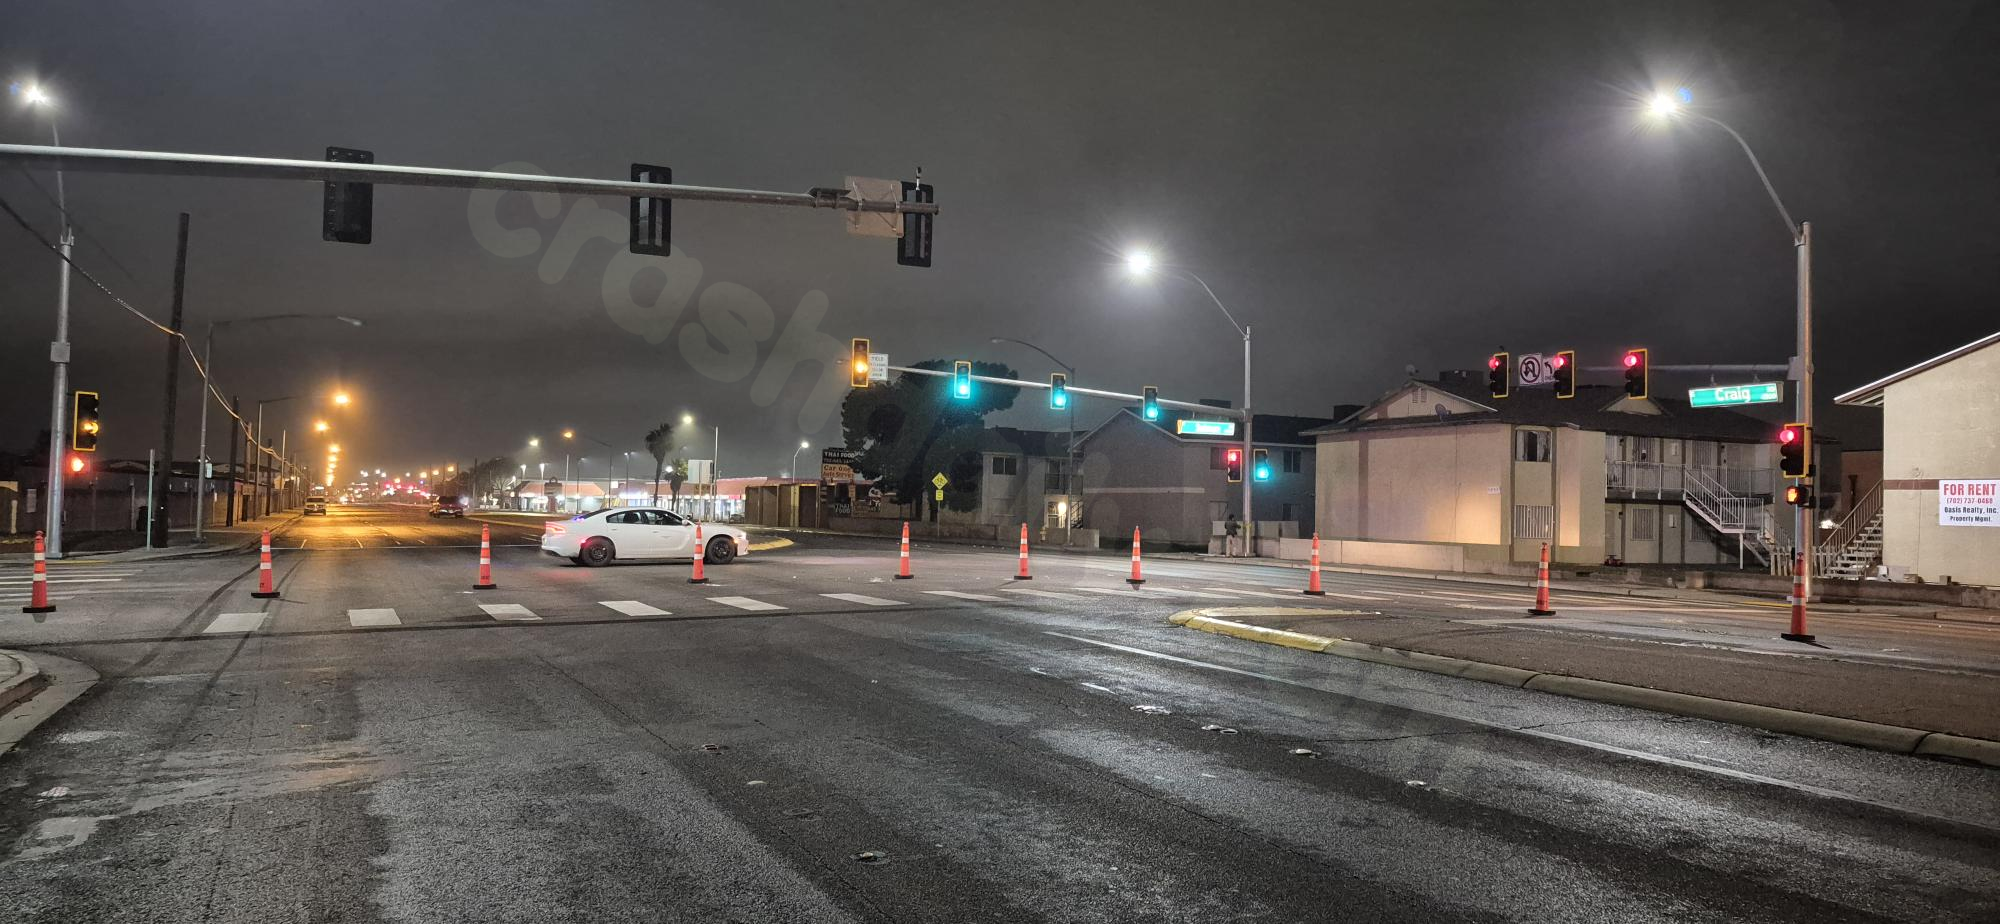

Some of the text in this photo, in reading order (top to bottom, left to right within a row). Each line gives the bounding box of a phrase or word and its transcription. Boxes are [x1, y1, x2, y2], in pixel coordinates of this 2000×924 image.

[1715, 387, 1751, 403] Craig
[1944, 484, 1996, 496] FOR RENT
[1962, 506, 1985, 514] Realty,
